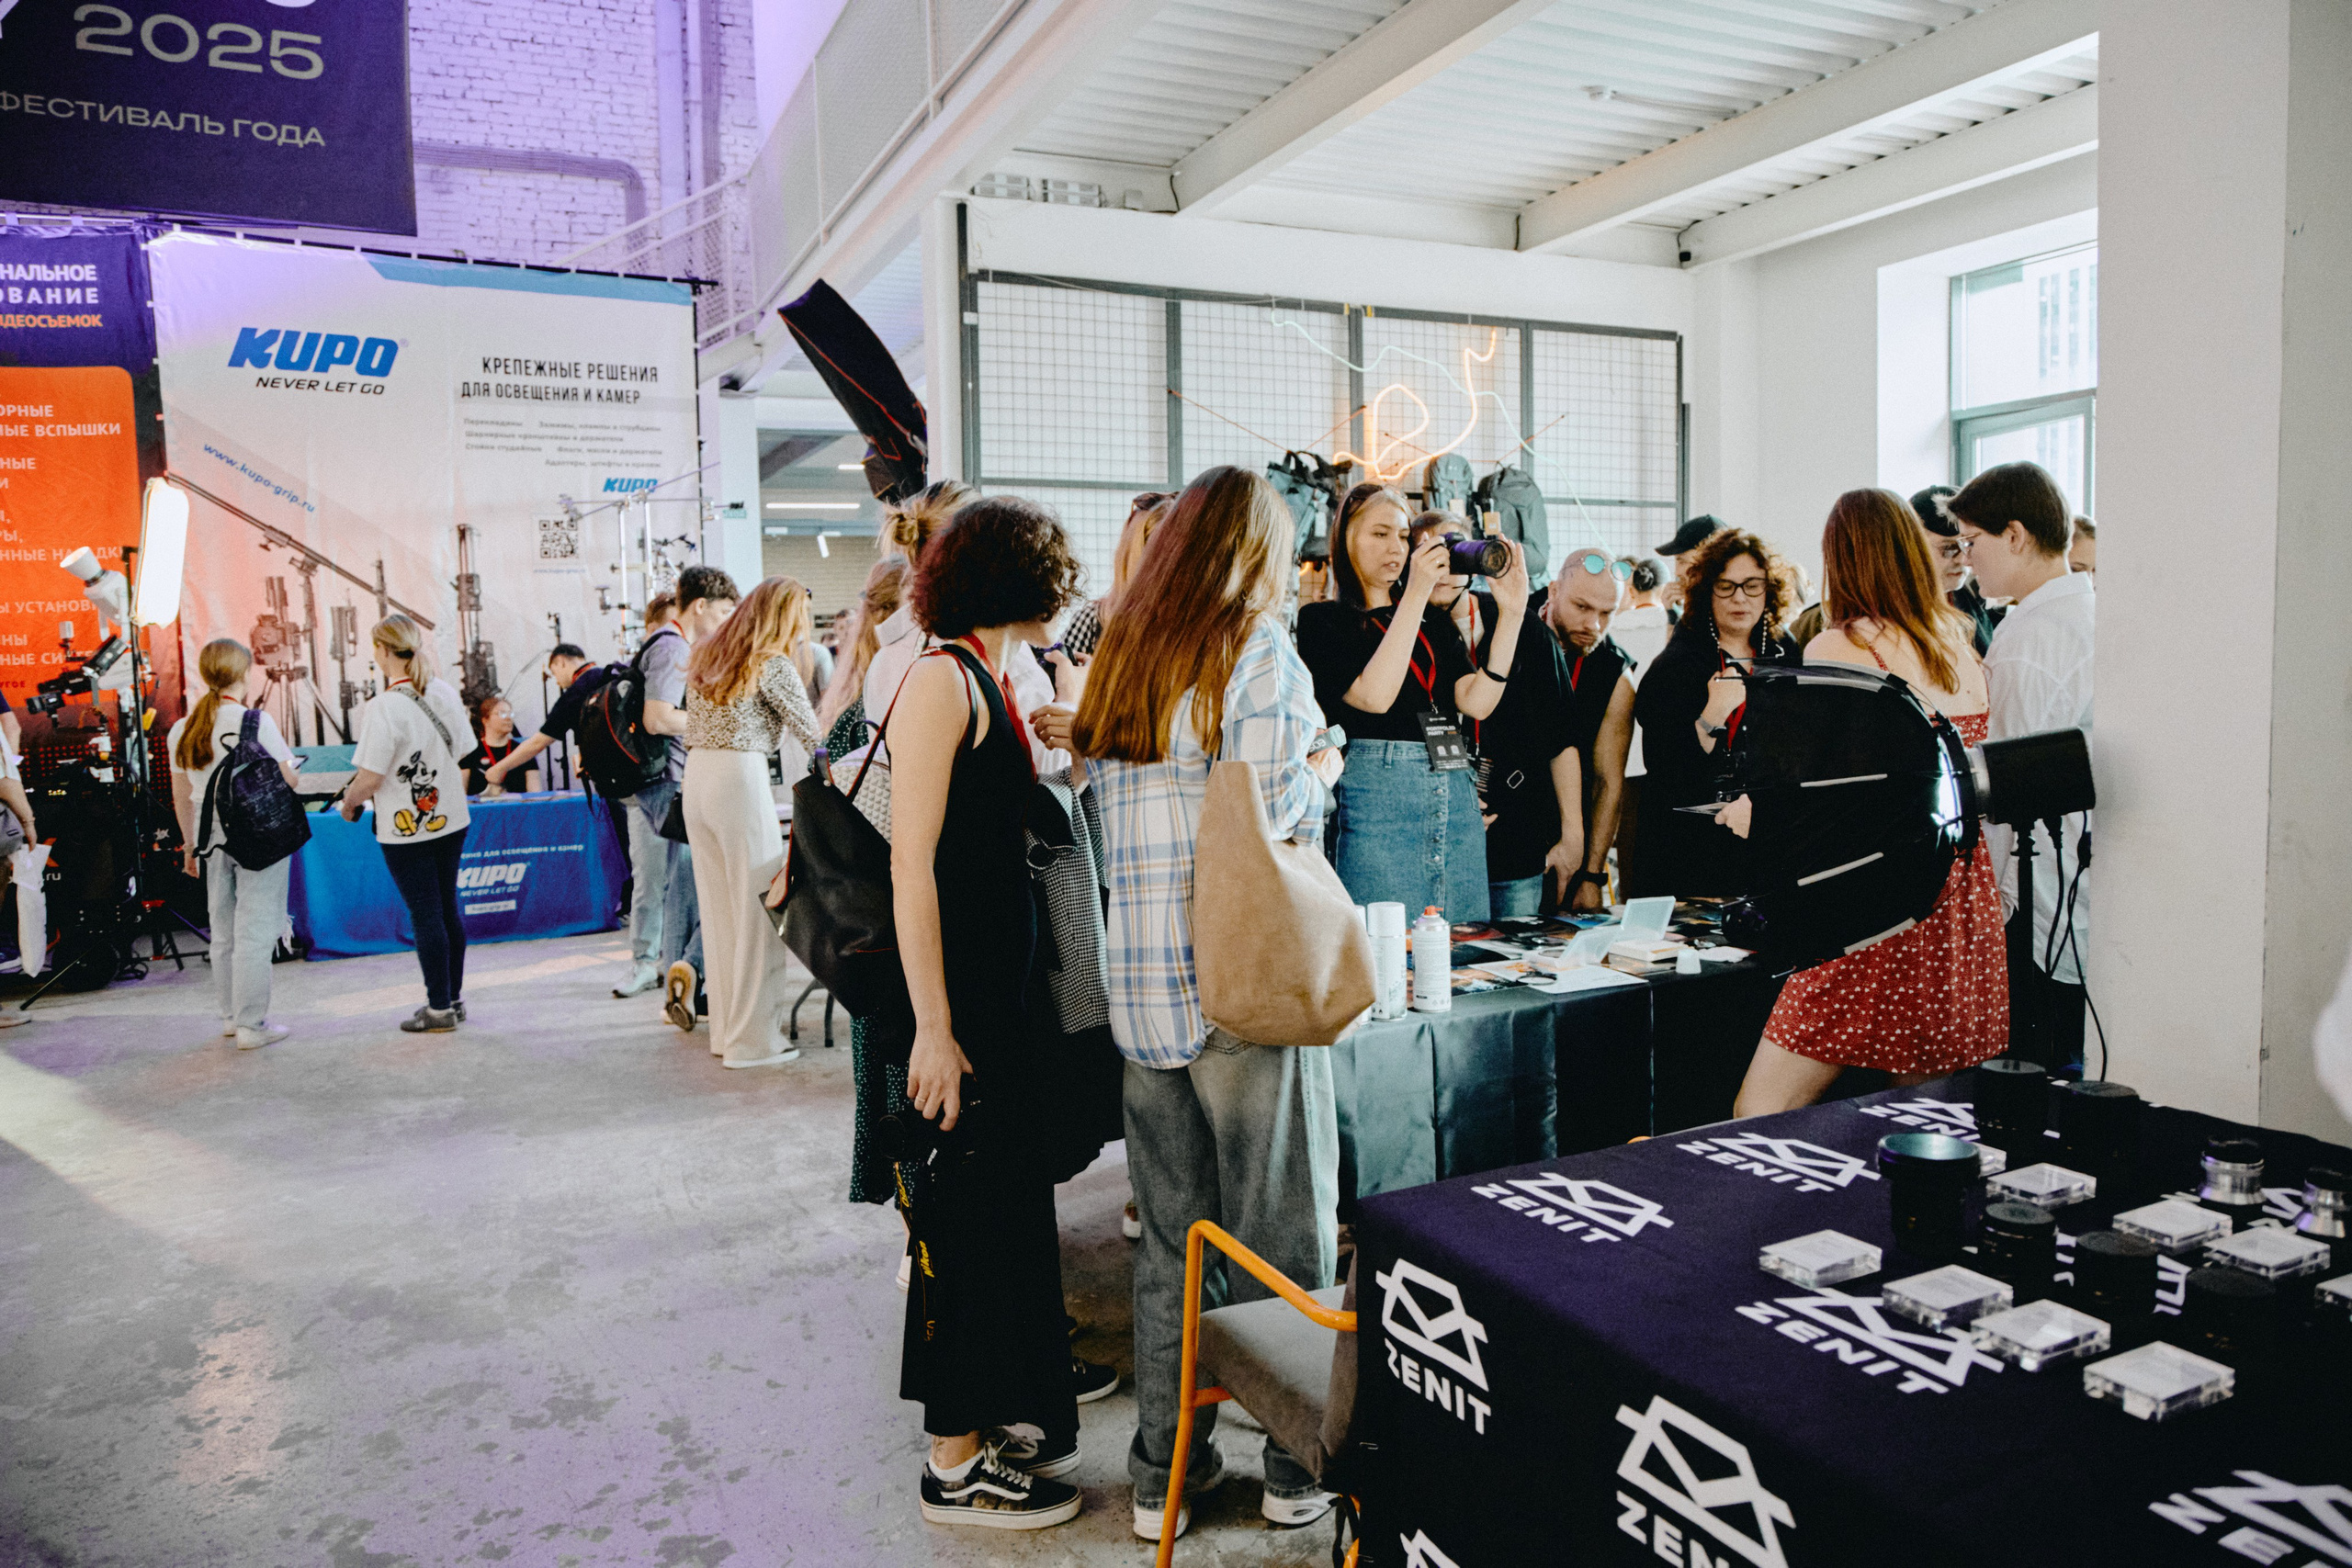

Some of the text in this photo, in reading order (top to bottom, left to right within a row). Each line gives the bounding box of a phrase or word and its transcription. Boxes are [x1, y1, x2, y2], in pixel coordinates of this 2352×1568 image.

[74, 4, 324, 80] 2025
[0, 91, 326, 148] ФЕСТИВАЛЬ ГОДА
[0, 287, 99, 304] ВАНИЕ
[227, 327, 400, 378] KUPO
[482, 356, 659, 383] КРЕПЕЖНЫЕ РЕШЕНИЯ
[255, 377, 386, 396] NEVER LET GO
[461, 382, 641, 404] ДЛЯ ОСВЕЩЕНИЯ И КАМЕР
[35, 423, 121, 437] ВСПЫШКИ
[204, 444, 315, 513] www.kupo-grip.ru
[457, 863, 528, 888] KUPO
[1859, 1105, 1981, 1142] ZENI
[1676, 1140, 1836, 1192] ZENIT
[1470, 1182, 1623, 1243] ZENIT
[1735, 1301, 1951, 1394] ZENIT
[1384, 1337, 1492, 1436] ZENIT
